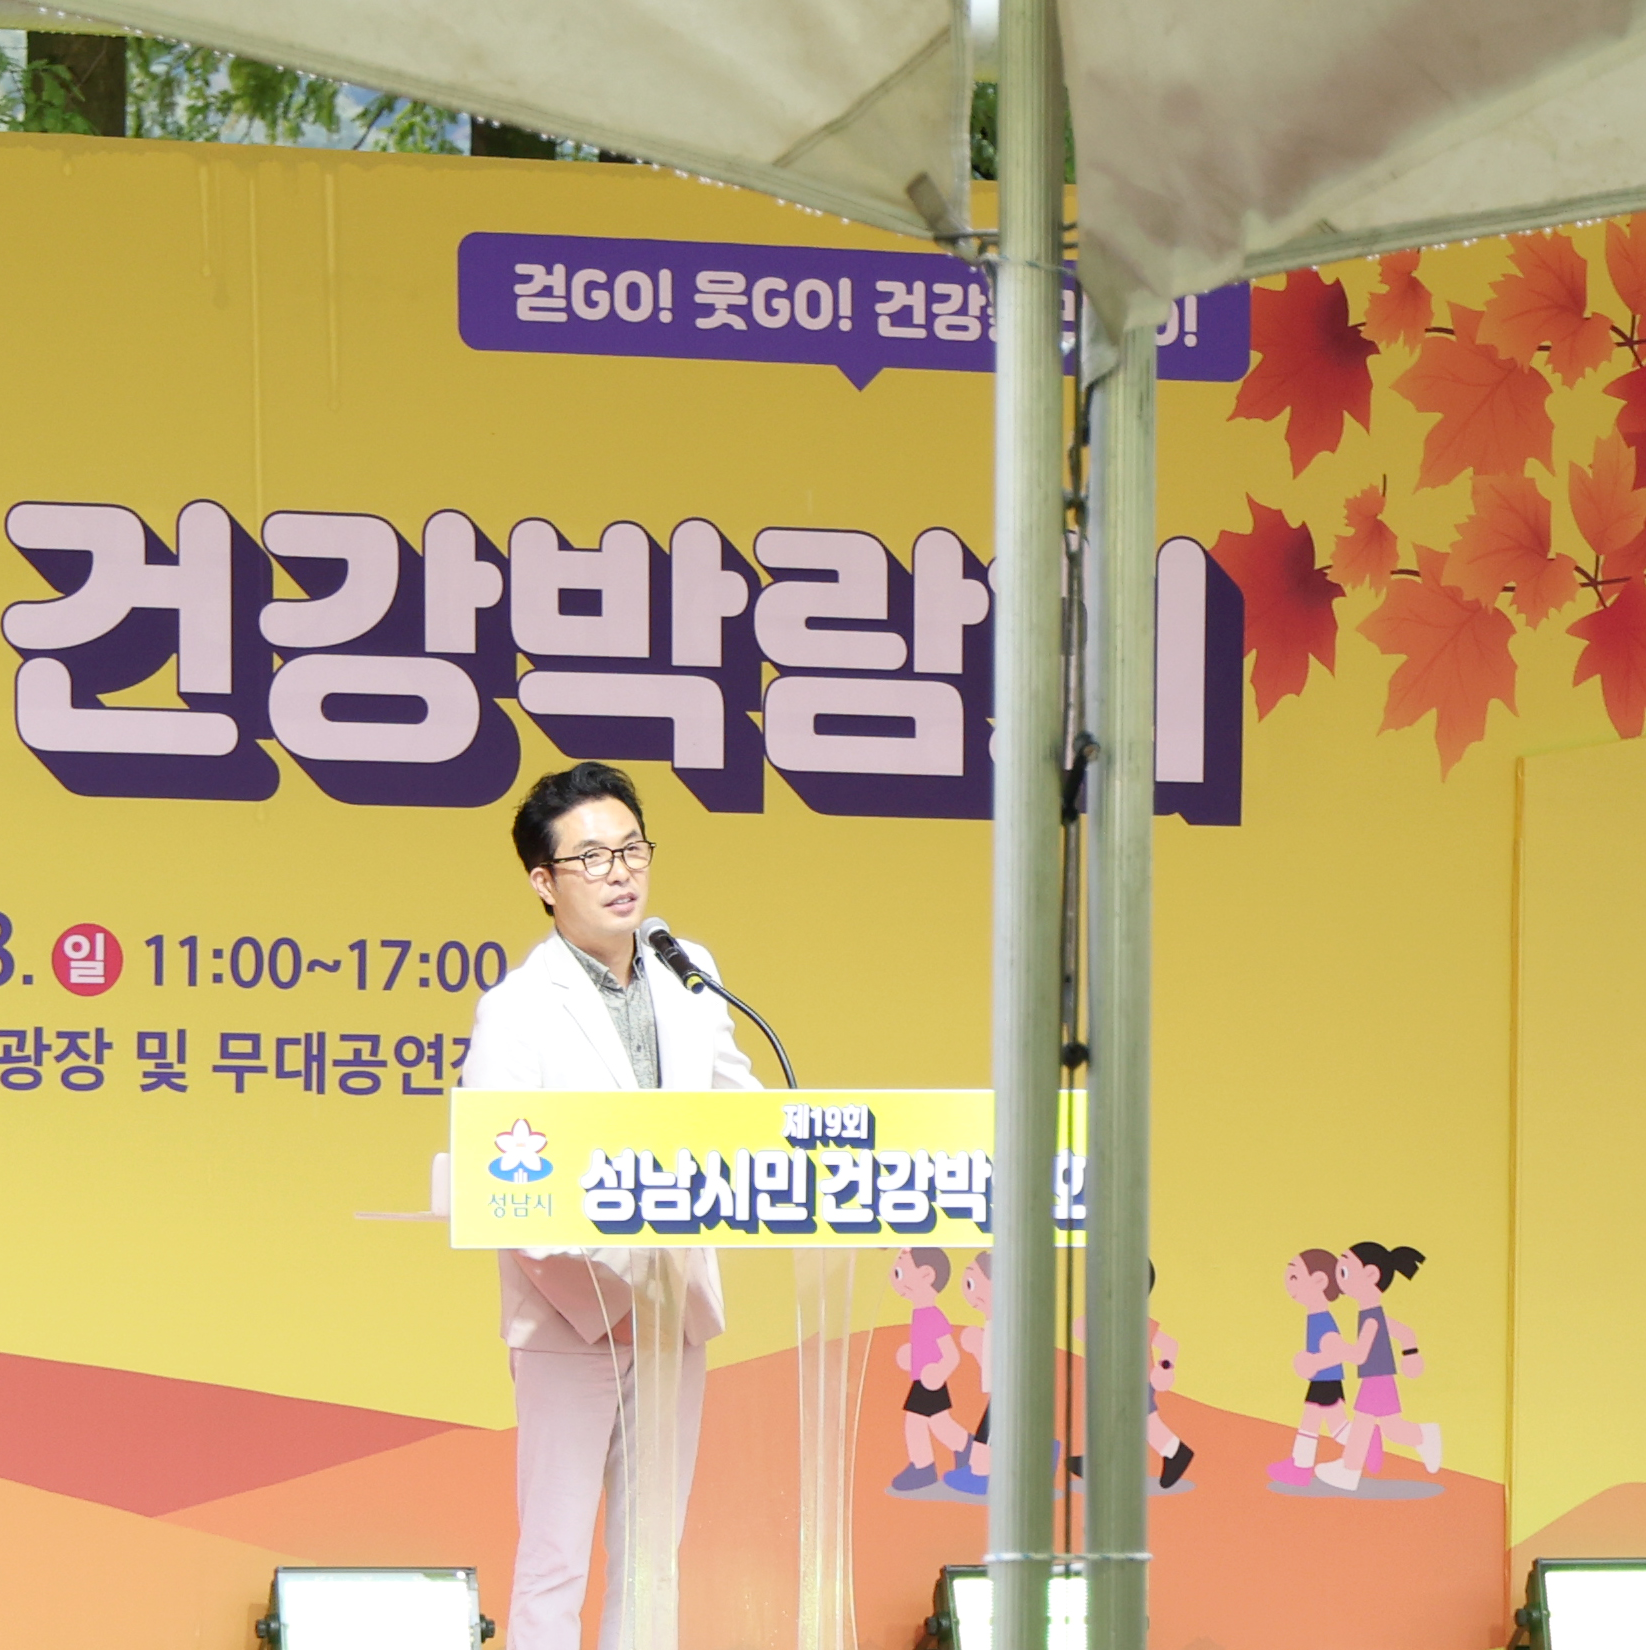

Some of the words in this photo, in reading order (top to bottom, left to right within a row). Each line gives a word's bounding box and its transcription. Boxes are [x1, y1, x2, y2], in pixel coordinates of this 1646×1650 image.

[513, 263, 674, 323] 걷GO!
[694, 271, 852, 332] 웃GO!
[62, 934, 106, 985] 일
[145, 933, 507, 992] 11:00~17:00
[137, 1028, 188, 1093] 및
[782, 1103, 872, 1142] 제19회
[487, 1192, 554, 1219] 성남시
[580, 1147, 809, 1224] 성남시민
[820, 1147, 1086, 1223] 건강박
